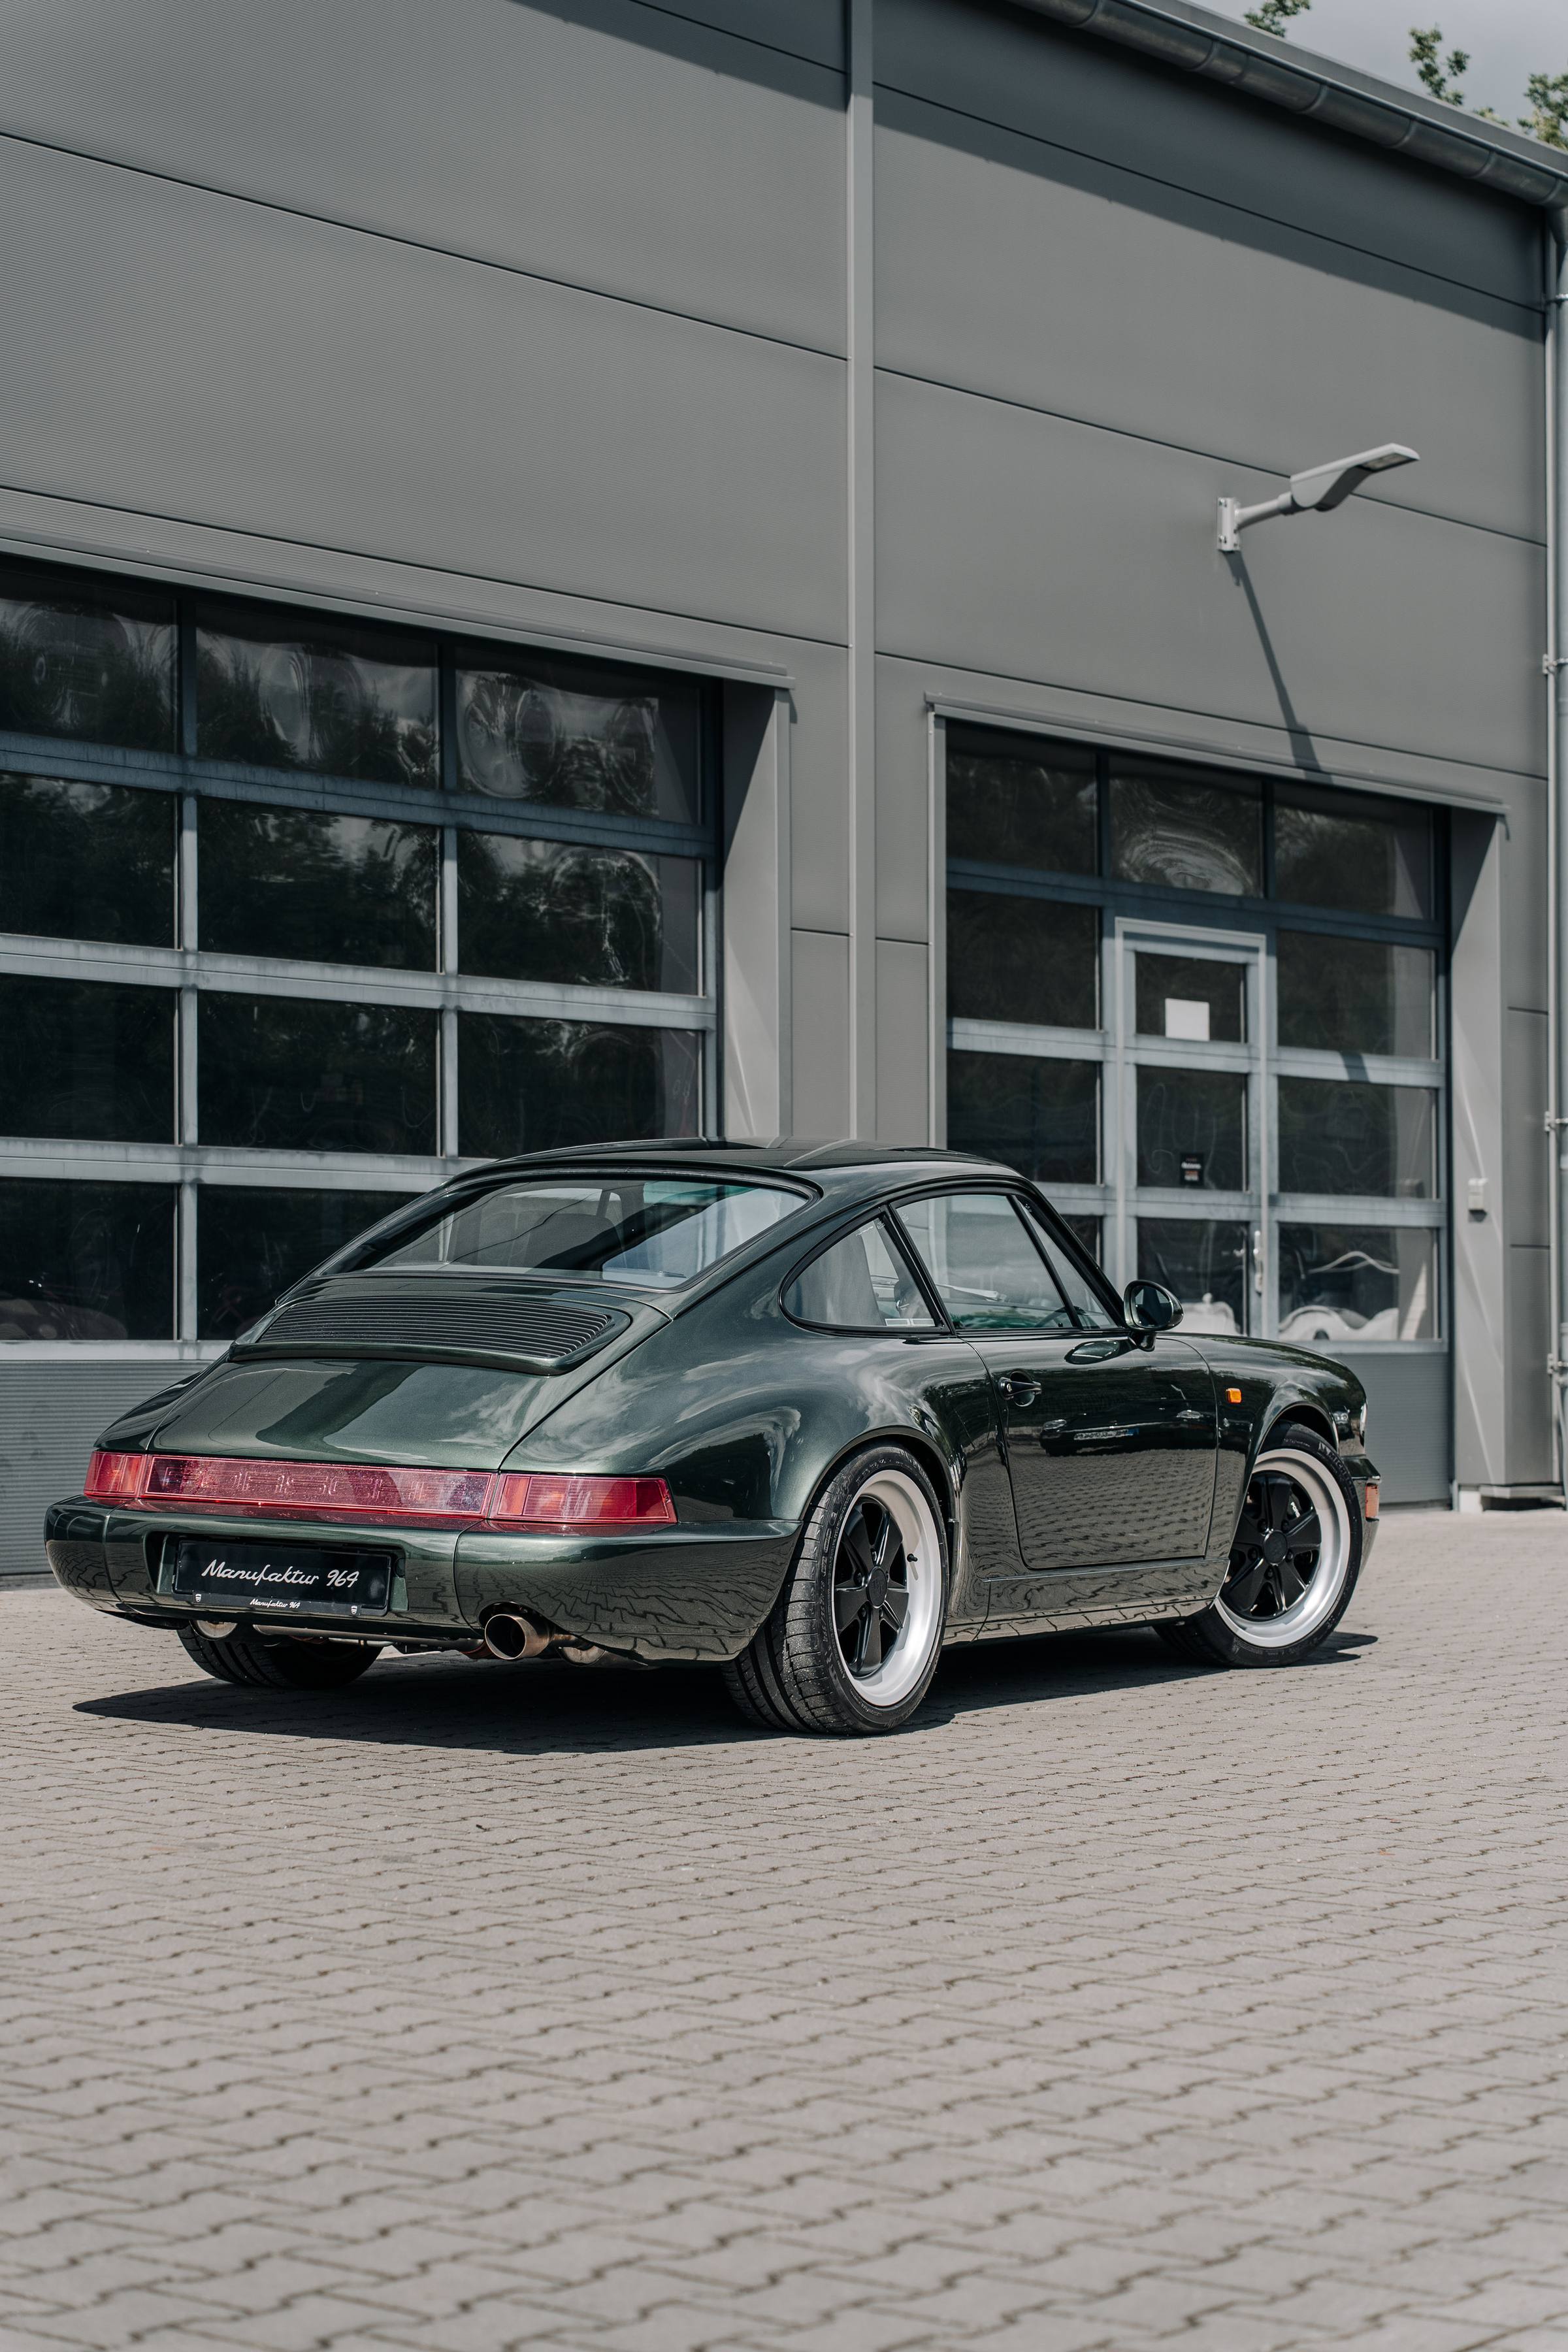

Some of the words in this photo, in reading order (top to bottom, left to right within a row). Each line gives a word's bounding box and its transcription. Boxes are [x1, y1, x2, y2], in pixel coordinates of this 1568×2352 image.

[201, 1559, 319, 1586] Manufaktur
[326, 1569, 360, 1588] 964
[250, 1598, 288, 1608] Manufaktur
